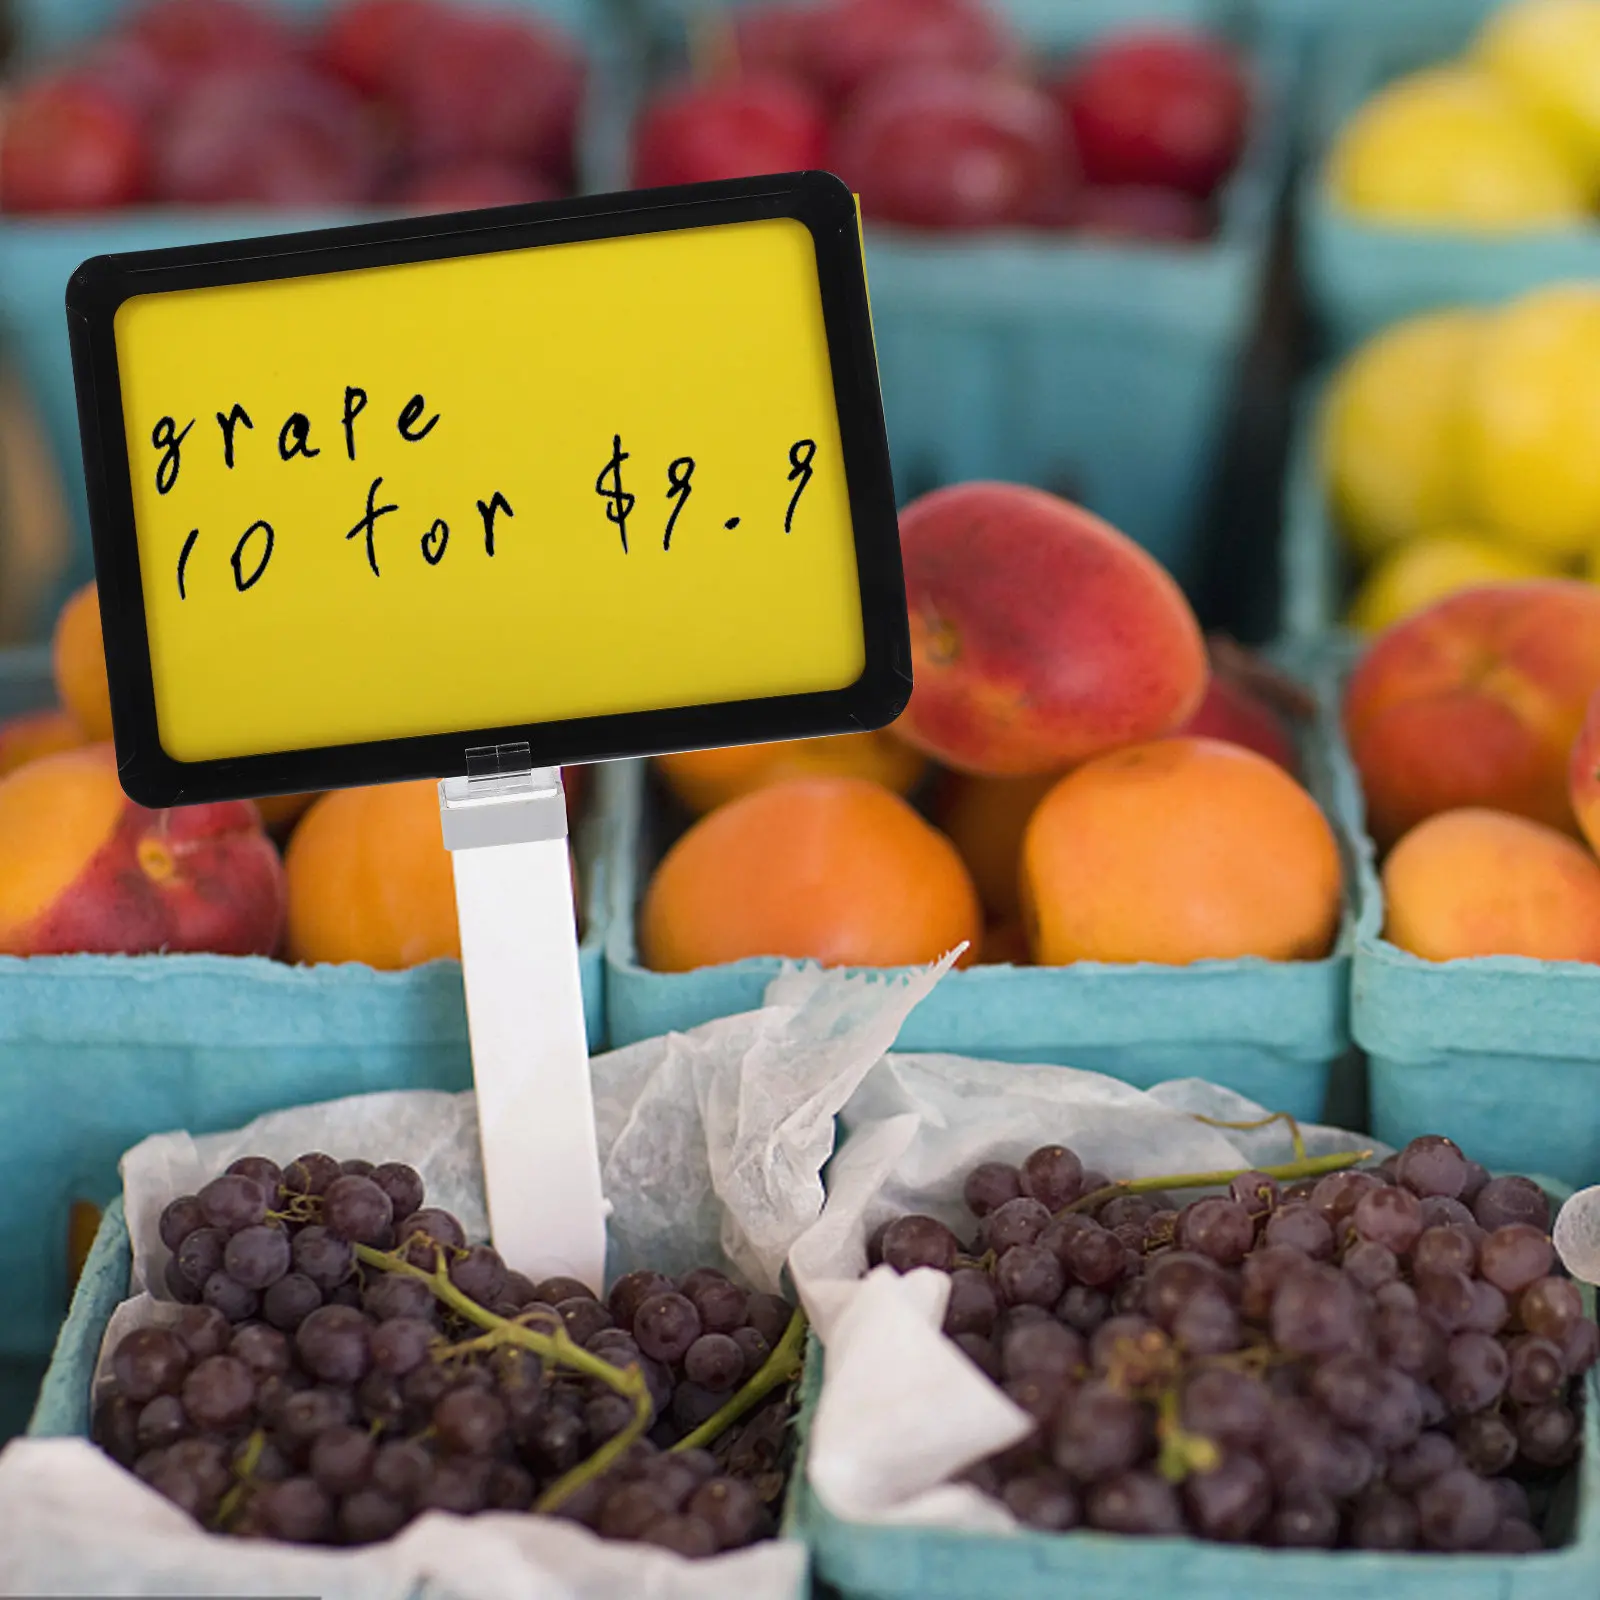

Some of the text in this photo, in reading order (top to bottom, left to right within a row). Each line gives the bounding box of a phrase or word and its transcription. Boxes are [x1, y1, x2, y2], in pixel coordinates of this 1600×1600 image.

[152, 386, 440, 495] grape
[177, 520, 275, 600] 10
[345, 476, 514, 577] for
